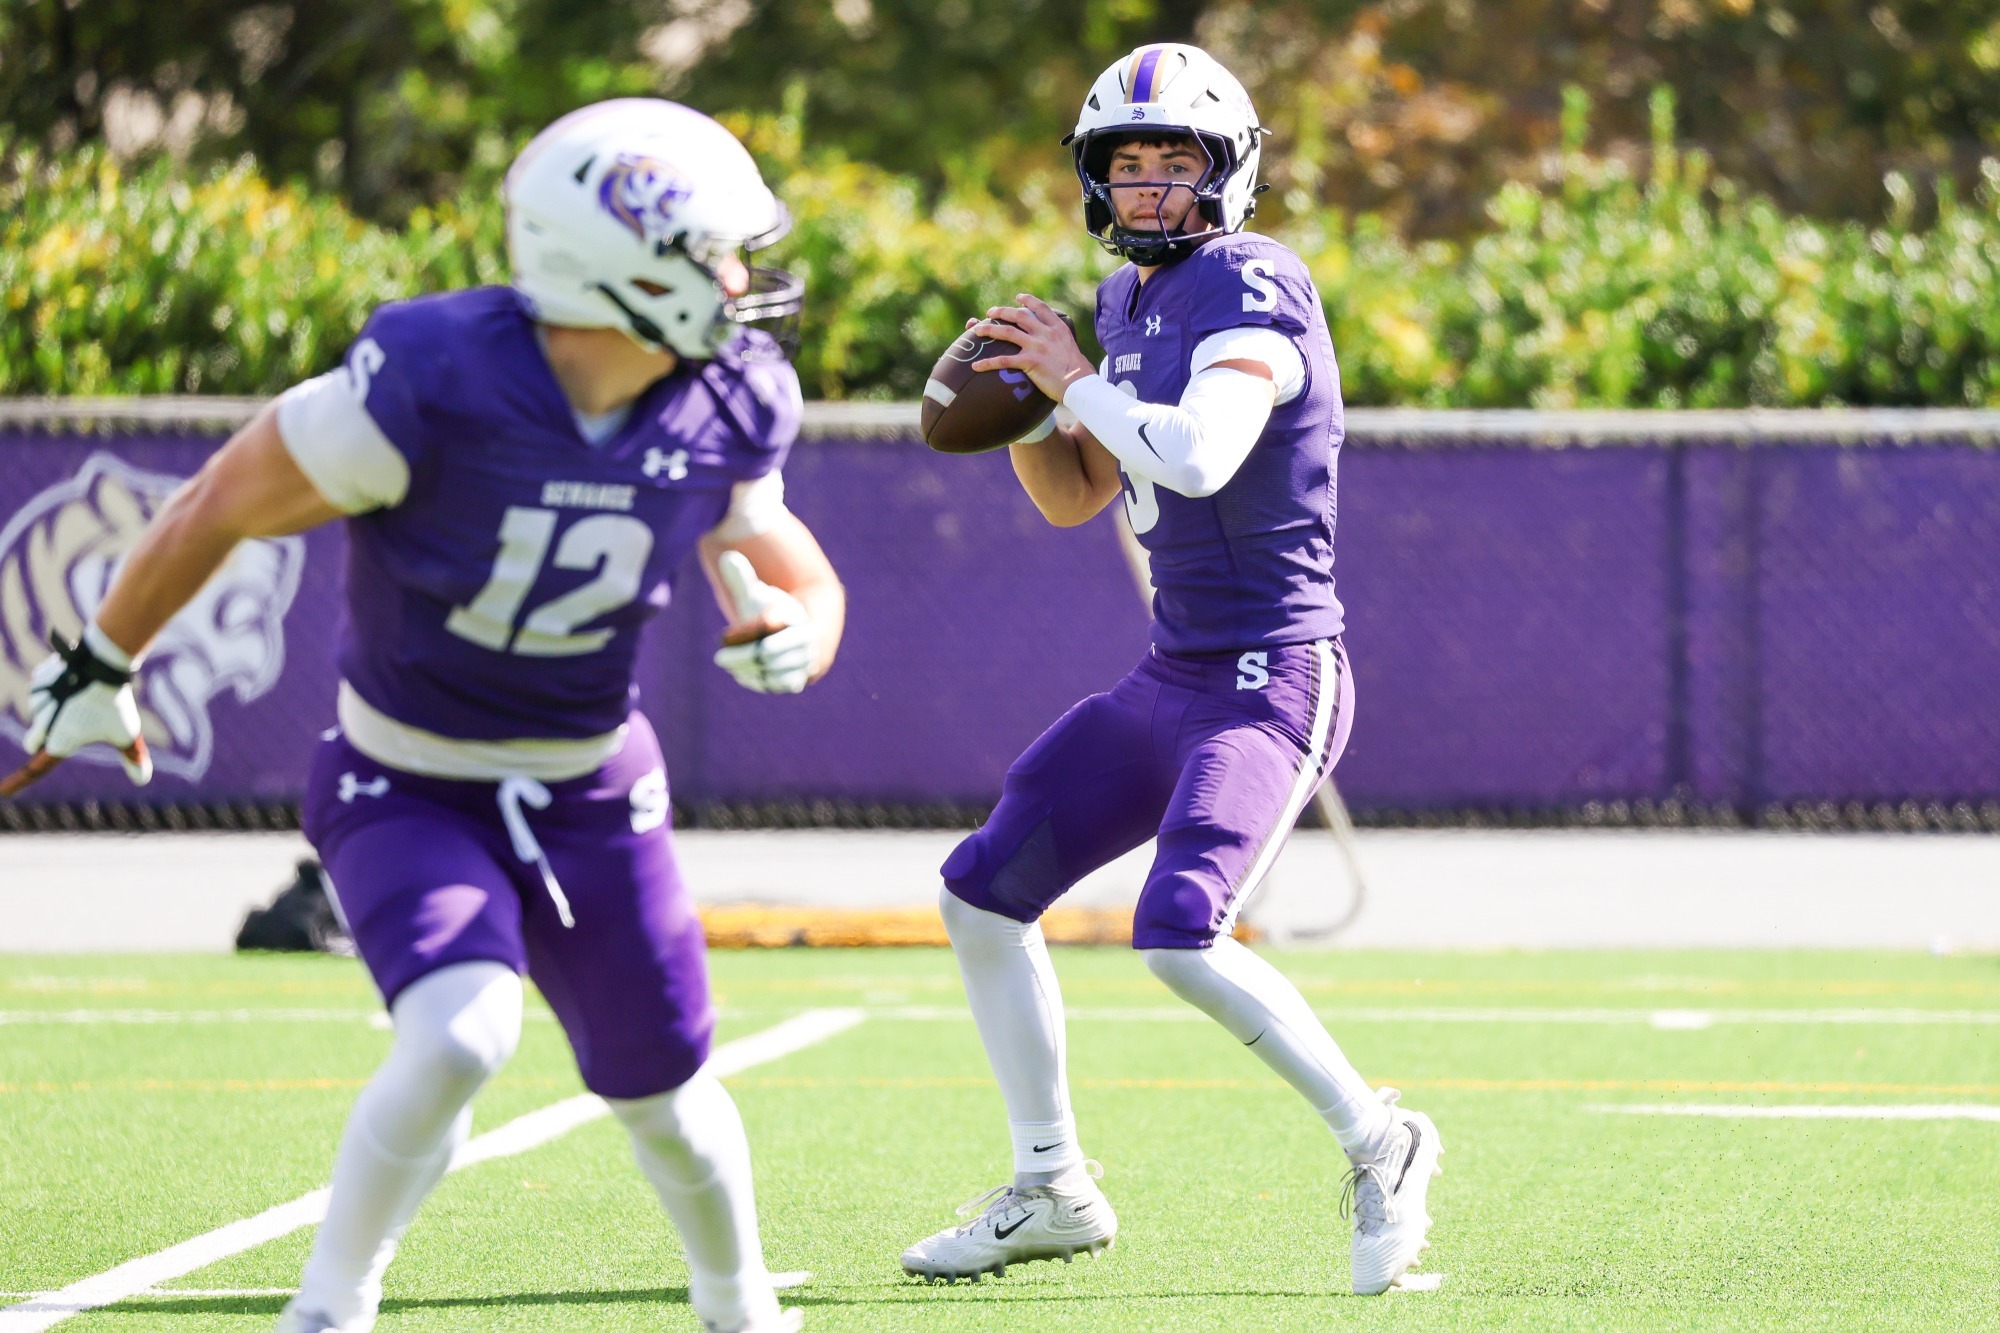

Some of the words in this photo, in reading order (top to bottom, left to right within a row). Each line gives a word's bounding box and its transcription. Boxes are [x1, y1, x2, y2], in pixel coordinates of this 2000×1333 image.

[1240, 259, 1279, 313] S
[444, 505, 655, 657] 12
[1236, 651, 1270, 690] S
[629, 766, 670, 834] S
